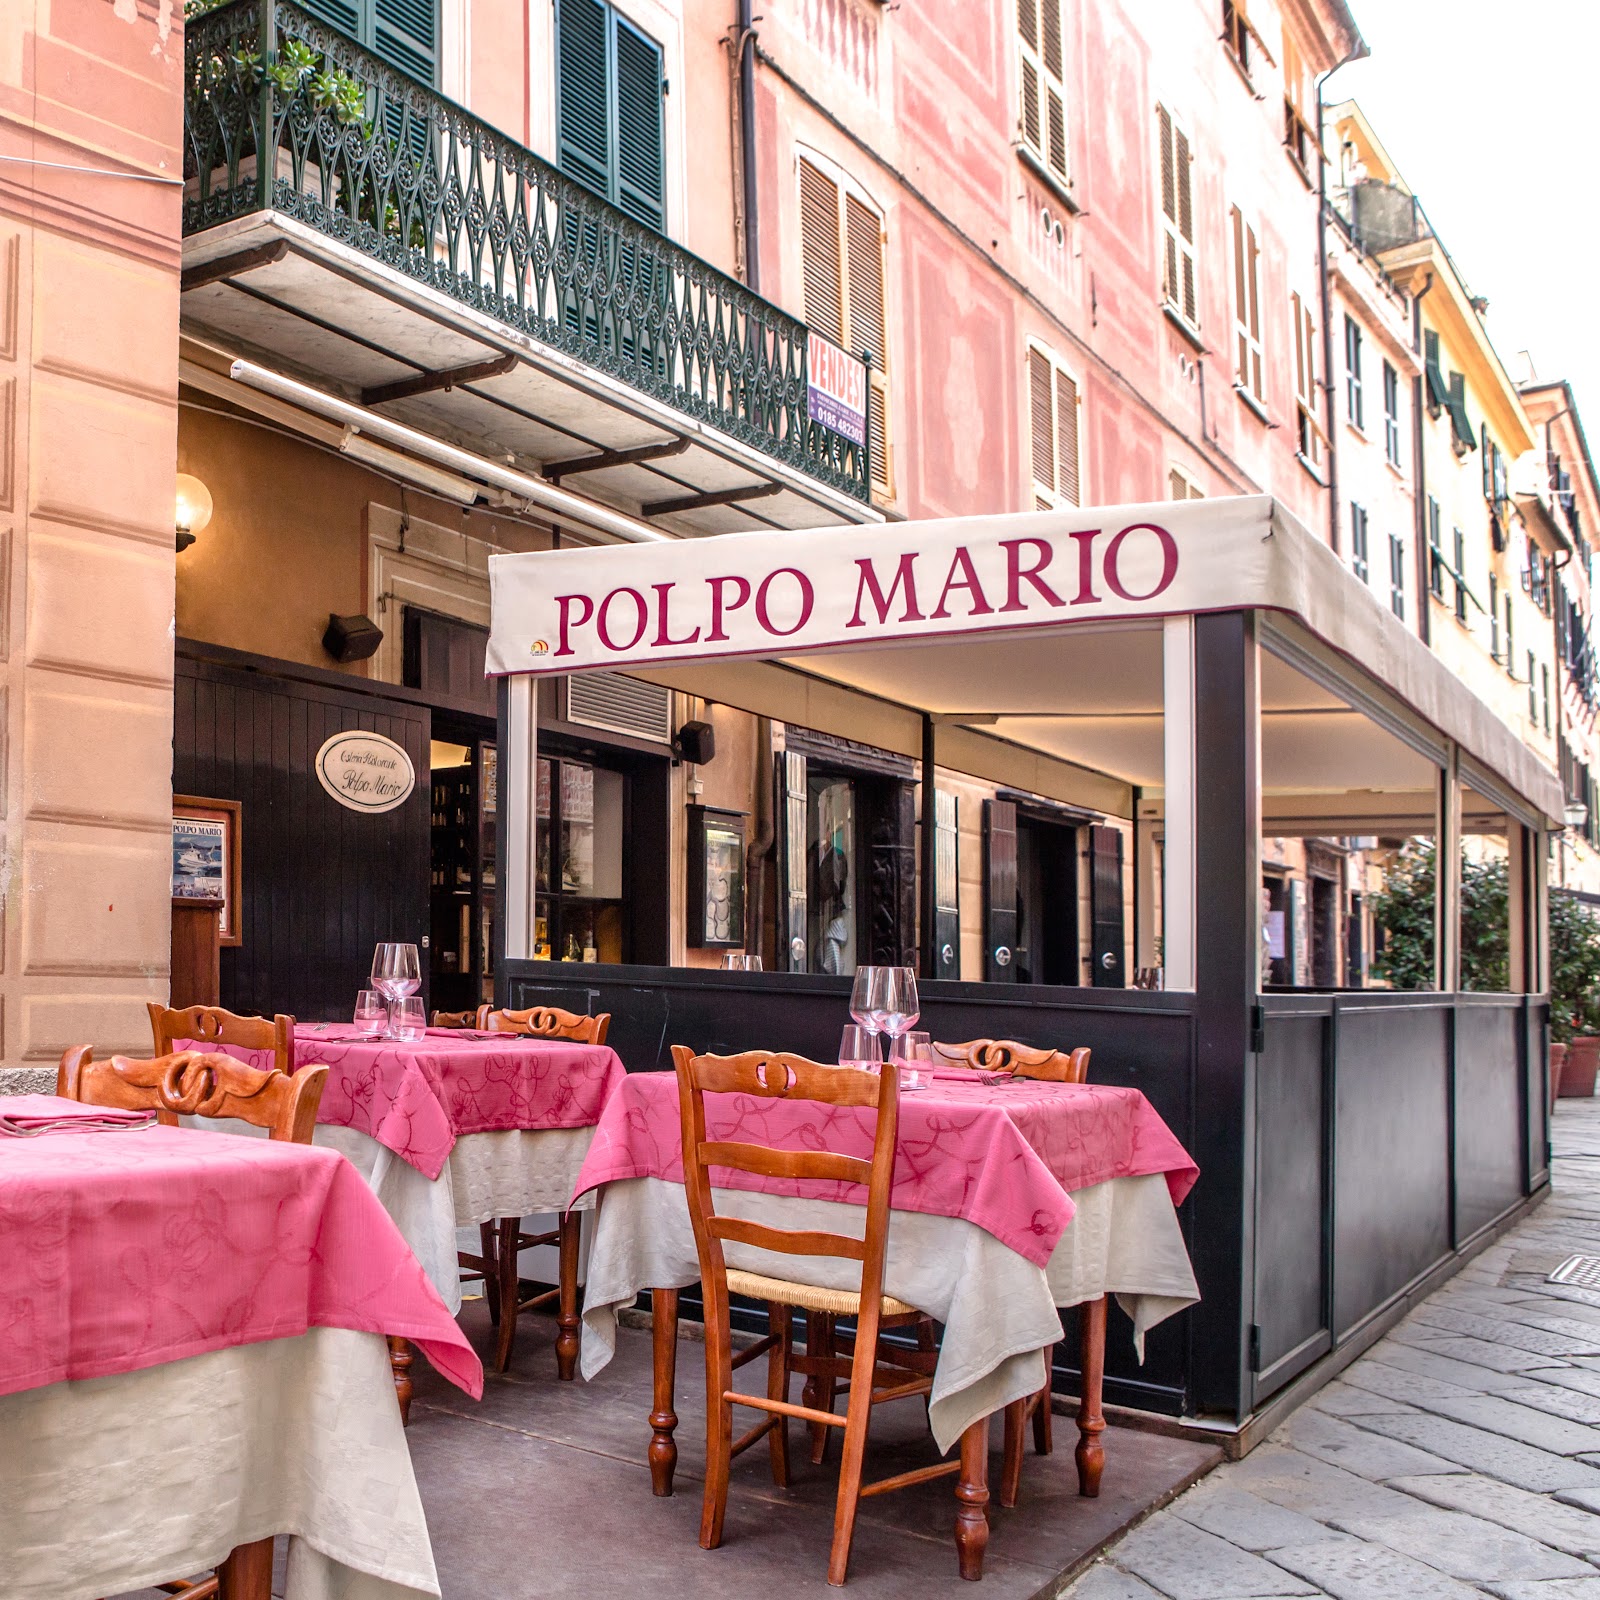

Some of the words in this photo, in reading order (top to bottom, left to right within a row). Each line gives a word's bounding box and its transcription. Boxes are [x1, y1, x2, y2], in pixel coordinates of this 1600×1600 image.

[809, 335, 865, 412] VENDESI
[817, 407, 836, 428] 0185
[553, 567, 815, 657] POLPO
[845, 523, 1179, 629] MARIO
[342, 769, 370, 796] Polpo
[370, 774, 401, 797] Mario
[173, 825, 197, 834] POLPO
[198, 827, 222, 835] MARIO
